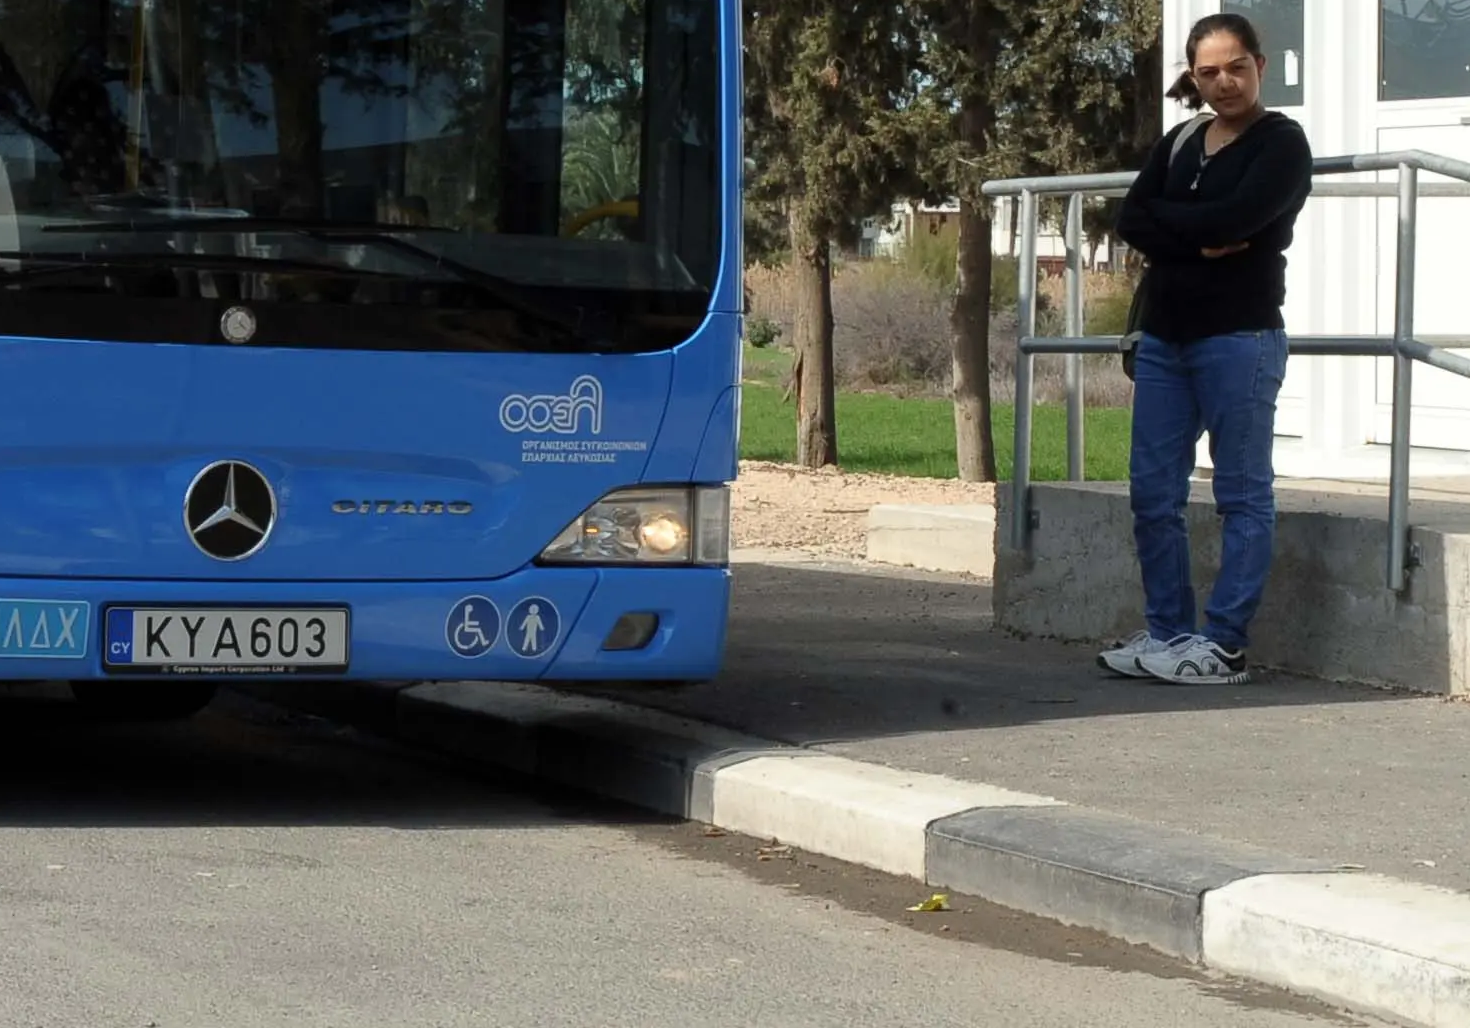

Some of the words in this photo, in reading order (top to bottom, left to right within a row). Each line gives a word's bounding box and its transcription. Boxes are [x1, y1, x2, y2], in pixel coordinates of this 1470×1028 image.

[522, 440, 579, 450] ΟΡΓΑΝΙΣΜΟΣ
[521, 452, 566, 463] ΕΠΑΡΧΙΑΣ
[332, 500, 473, 515] CITARO
[2, 607, 79, 649] ΛΔΧ
[110, 641, 131, 655] CY
[145, 615, 327, 658] KYA603
[173, 665, 199, 674] Cyprus
[201, 665, 227, 674] Import
[229, 665, 270, 674] Corporation
